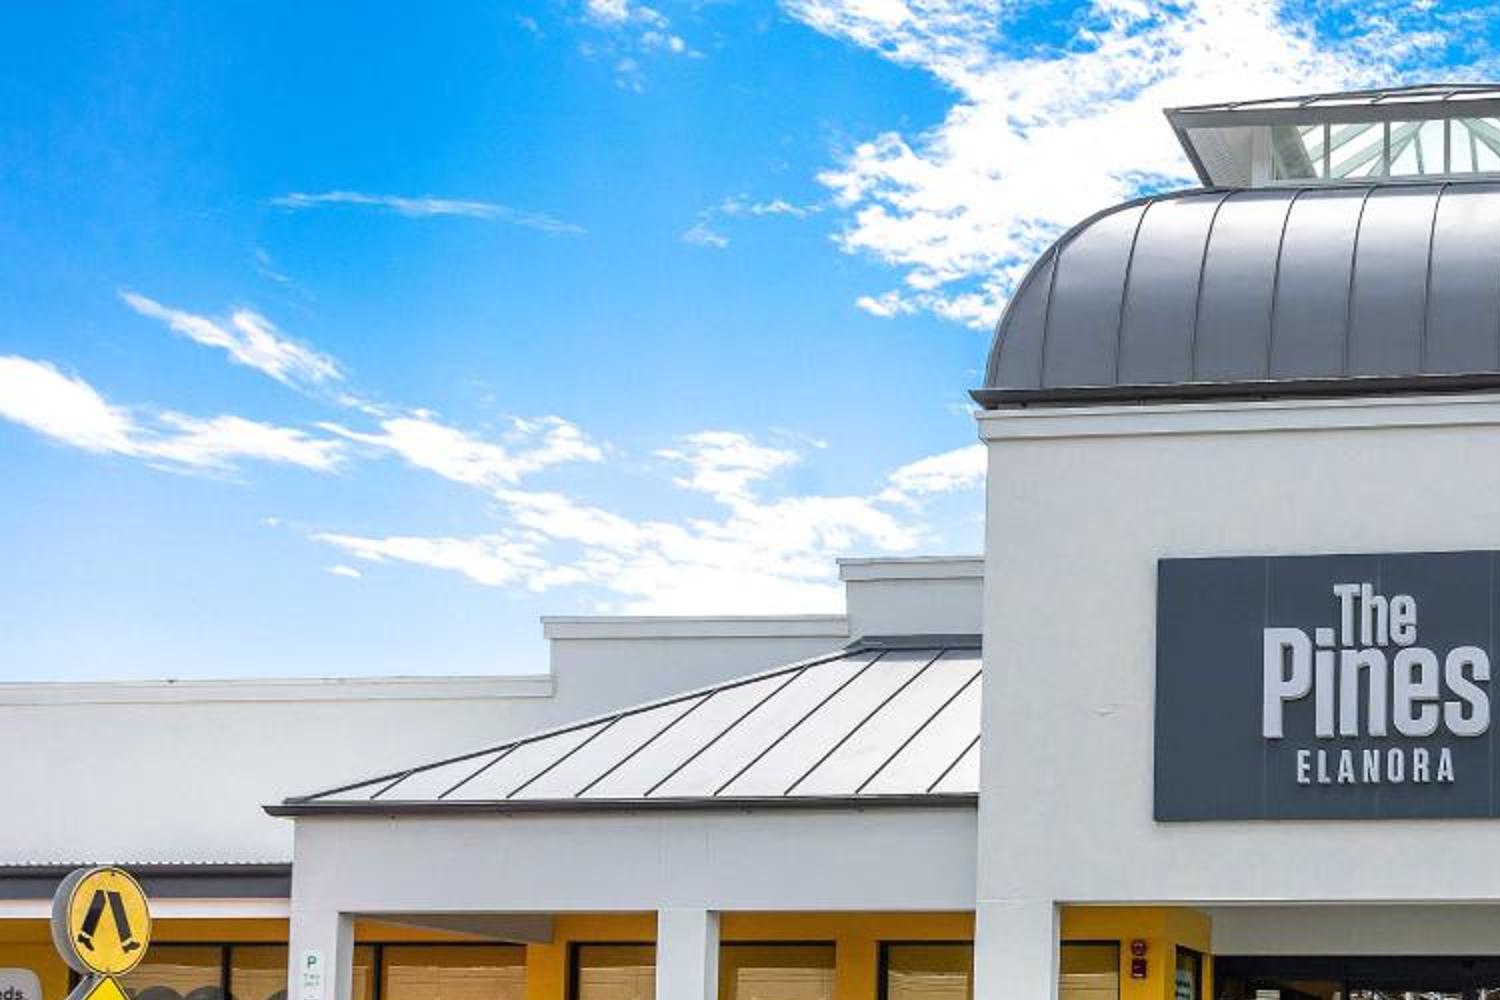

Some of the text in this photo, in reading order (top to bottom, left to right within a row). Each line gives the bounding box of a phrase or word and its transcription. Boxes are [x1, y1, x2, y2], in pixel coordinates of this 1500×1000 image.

[1333, 583, 1417, 647] The
[1263, 626, 1491, 739] Pines
[1297, 747, 1455, 784] ELANORA
[307, 955, 317, 968] P
